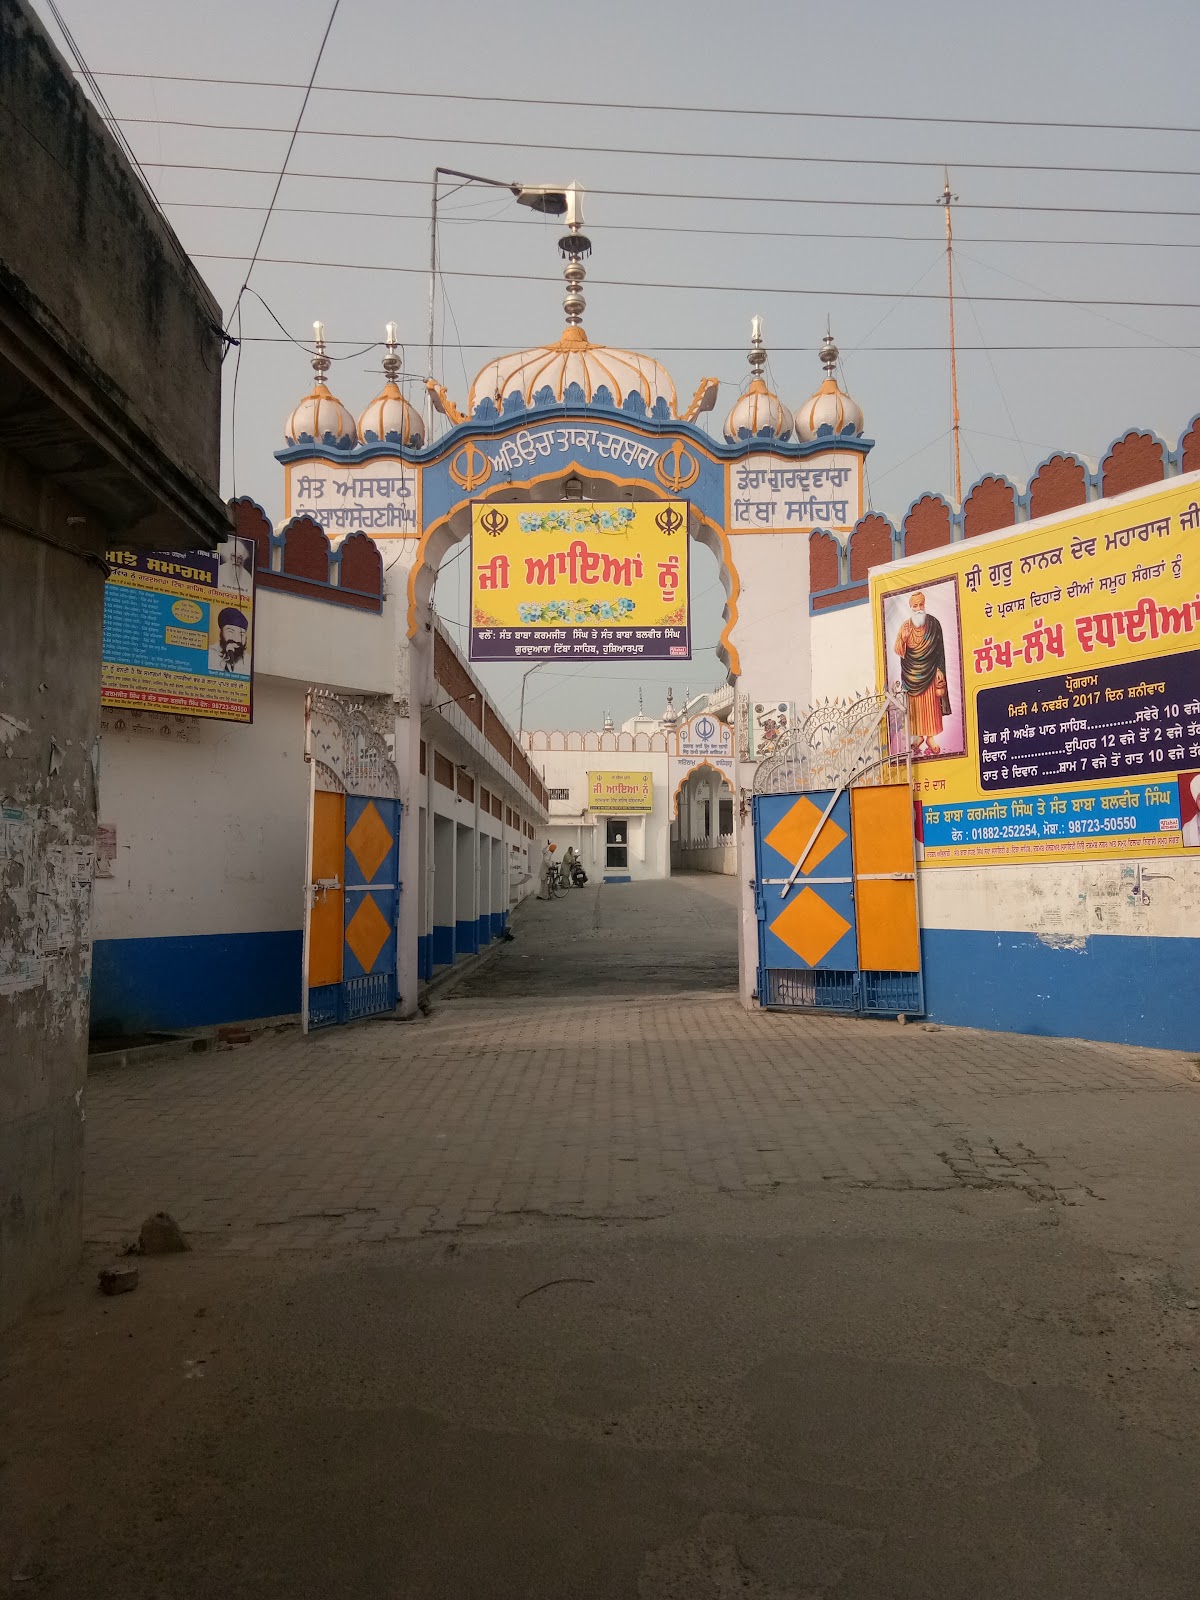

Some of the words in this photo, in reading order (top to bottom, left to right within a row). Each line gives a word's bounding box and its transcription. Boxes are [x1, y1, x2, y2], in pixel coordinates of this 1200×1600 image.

[597, 432, 660, 470] ਦਰਬਾਰਾ
[297, 475, 327, 499] ਸੰਤ
[734, 498, 777, 523] ਟਿੱਬਾ
[785, 495, 848, 523] ਸਾਹਿਬ
[988, 561, 1013, 587] ਗੁਰੂ
[1020, 546, 1063, 574] ਨਾਨਕ
[1070, 536, 1097, 560] ਦੇਵ
[1105, 516, 1171, 550] ਮਹਾਰਾਜ
[1179, 502, 1200, 531] ਜੀ
[146, 557, 212, 583] ਸਮਾਗਮ
[477, 554, 510, 590] ਜੀ
[524, 540, 644, 587] ਆਇਆਂ
[657, 555, 680, 602] ਨੂੰ
[984, 602, 993, 618] ਦੇ
[997, 598, 1026, 619] ਪ੍ਰਕਾਸ਼
[1030, 585, 1062, 608] ਦਿਹਾੜੇ
[1066, 577, 1094, 599] ਦੀਆਂ
[1100, 572, 1127, 594] ਸਮੂਹ
[1132, 559, 1166, 583] ਸੰਗਤਾਂ
[1171, 553, 1183, 579] ਨੂੰ
[499, 629, 512, 640] ਸੰਤ
[515, 631, 532, 640] ਬਾਬਾ
[534, 629, 567, 640] ਕਰਮਜੀਤ
[573, 628, 588, 639] ਸਿੰਘ
[591, 629, 598, 639] ਤੇ
[601, 628, 613, 639] ਸੰਤ
[616, 630, 633, 639] ਬਾਬਾ
[636, 628, 661, 639] ਬਲਵੀਰ
[664, 628, 680, 639] ਸਿੰਘ
[515, 645, 551, 656] ਗੁਰਦੁਆਰਾ
[554, 643, 571, 654] ਟਿੱਬਾ
[973, 618, 1065, 674] ਲੱਖ-ਲੱਖ
[1008, 702, 1028, 718] ਮਿਤੀ
[1031, 702, 1038, 714] 4
[1073, 691, 1100, 708] 2017
[1105, 689, 1124, 702] ਦਿਨ
[1128, 681, 1166, 699] ਸ਼ਨੀਵਾਰ
[1065, 675, 1099, 693] ਪ੍ਰੋਗਰਾਮ
[983, 730, 997, 744] ਭੋਗ
[1013, 724, 1036, 739] ਅਖੰਡ
[1039, 724, 1057, 736] ਪਾਠ
[1164, 703, 1179, 718] 10
[982, 749, 1007, 763] ਦਿਵਾਨ
[1101, 734, 1116, 748] 12
[1119, 730, 1136, 746] ਵਜੇ
[1139, 727, 1150, 742] ਤੋਂ
[1154, 728, 1163, 741] 2
[1166, 723, 1183, 739] ਵਜੇ
[983, 769, 998, 781] ਰਾਤ
[1001, 766, 1009, 779] ਦੇ
[1012, 764, 1038, 778] ਦਿਵਾਨ
[1081, 758, 1088, 770] 7
[1091, 754, 1107, 769] ਵਜੇ
[1111, 752, 1121, 766] ਤੋਂ
[1125, 753, 1144, 765] ਰਾਤ
[1148, 749, 1164, 762] 10
[1168, 744, 1185, 760] ਵਜੇ
[933, 779, 946, 791] ਦਾਸ
[925, 808, 940, 824] ਸੰਤ
[943, 809, 963, 823] ਬਾਬਾ
[967, 802, 1008, 821] ਕਰਮਜੀਤ
[1011, 799, 1033, 817] ਸਿੰਘ
[1037, 798, 1045, 815] ਤੇ
[1050, 796, 1067, 814] ਸੰਤ
[1071, 798, 1096, 813] ਬਾਬਾ
[1100, 790, 1140, 810] ਬਲਵੀਰ
[1145, 786, 1171, 806] ਸਿੰਘ
[951, 827, 963, 841] ਫੋਨ
[1068, 816, 1137, 834] 98723-50550
